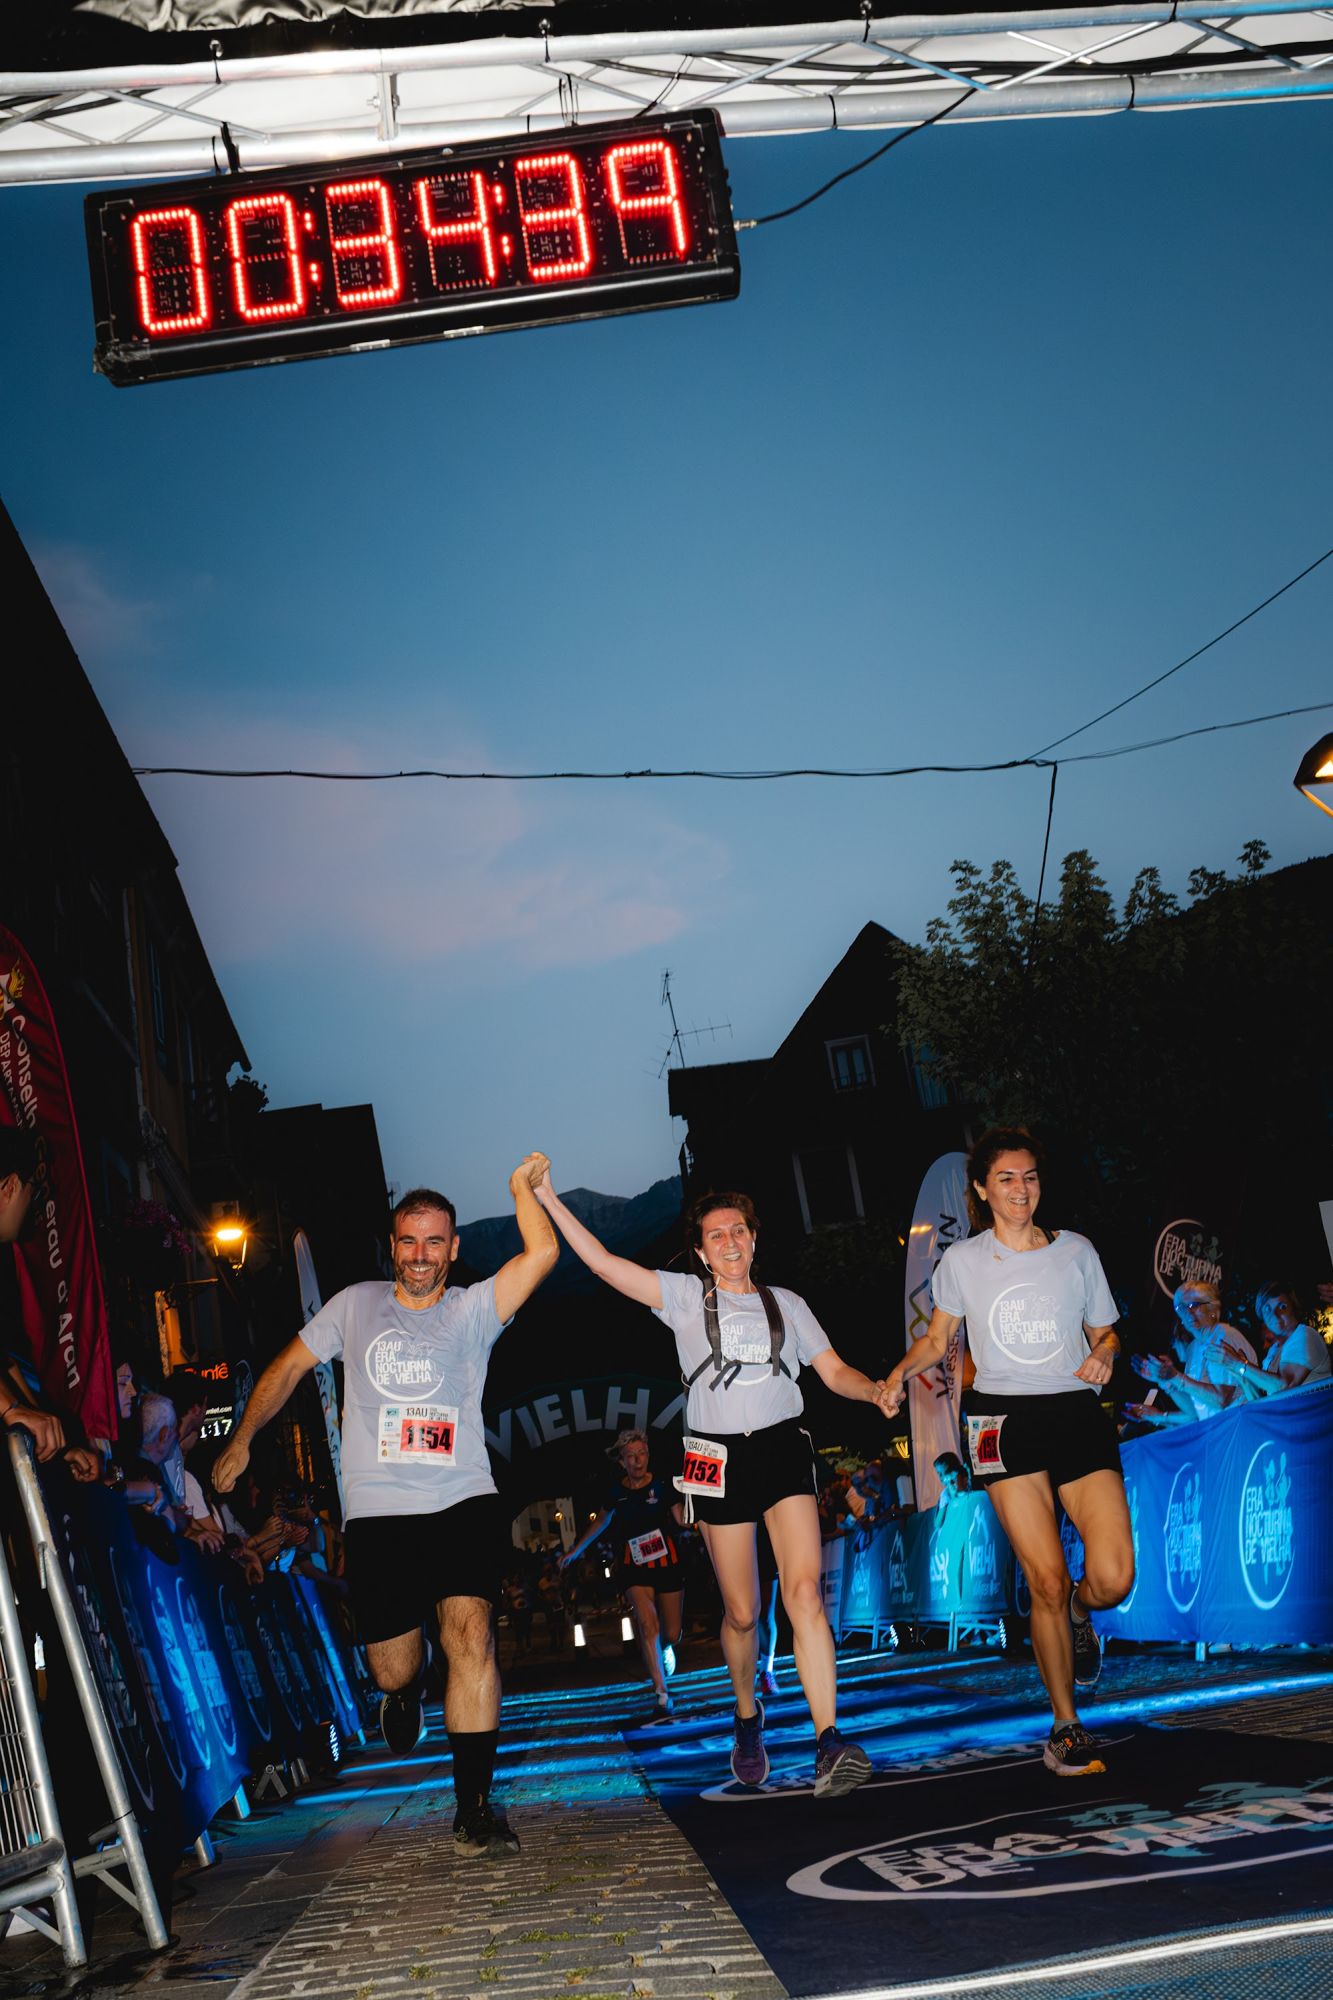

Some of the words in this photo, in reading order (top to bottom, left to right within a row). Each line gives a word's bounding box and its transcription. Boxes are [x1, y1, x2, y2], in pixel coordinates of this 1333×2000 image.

[132, 140, 688, 334] 00:34:39
[11, 1014, 39, 1129] Conselh
[1164, 1232, 1187, 1256] ERA
[1159, 1259, 1175, 1278] DE
[1160, 1246, 1222, 1281] NOCTURNA
[999, 1299, 1025, 1312] 13AU
[999, 1311, 1021, 1323] ERA
[999, 1320, 1057, 1334] NOCTURNA
[375, 1340, 402, 1352] 13AU
[1001, 1333, 1016, 1345] DE
[1020, 1331, 1057, 1345] VIELHA
[375, 1351, 396, 1363] ERA
[375, 1359, 432, 1374] NOCTURNA
[376, 1373, 391, 1385] DE
[395, 1370, 433, 1385] VIELHA
[684, 1458, 719, 1484] 1152
[1245, 1485, 1264, 1513] ERA
[1244, 1507, 1293, 1538] NOCTURNA
[1244, 1537, 1258, 1565] DE
[1260, 1534, 1293, 1564] VIELHA
